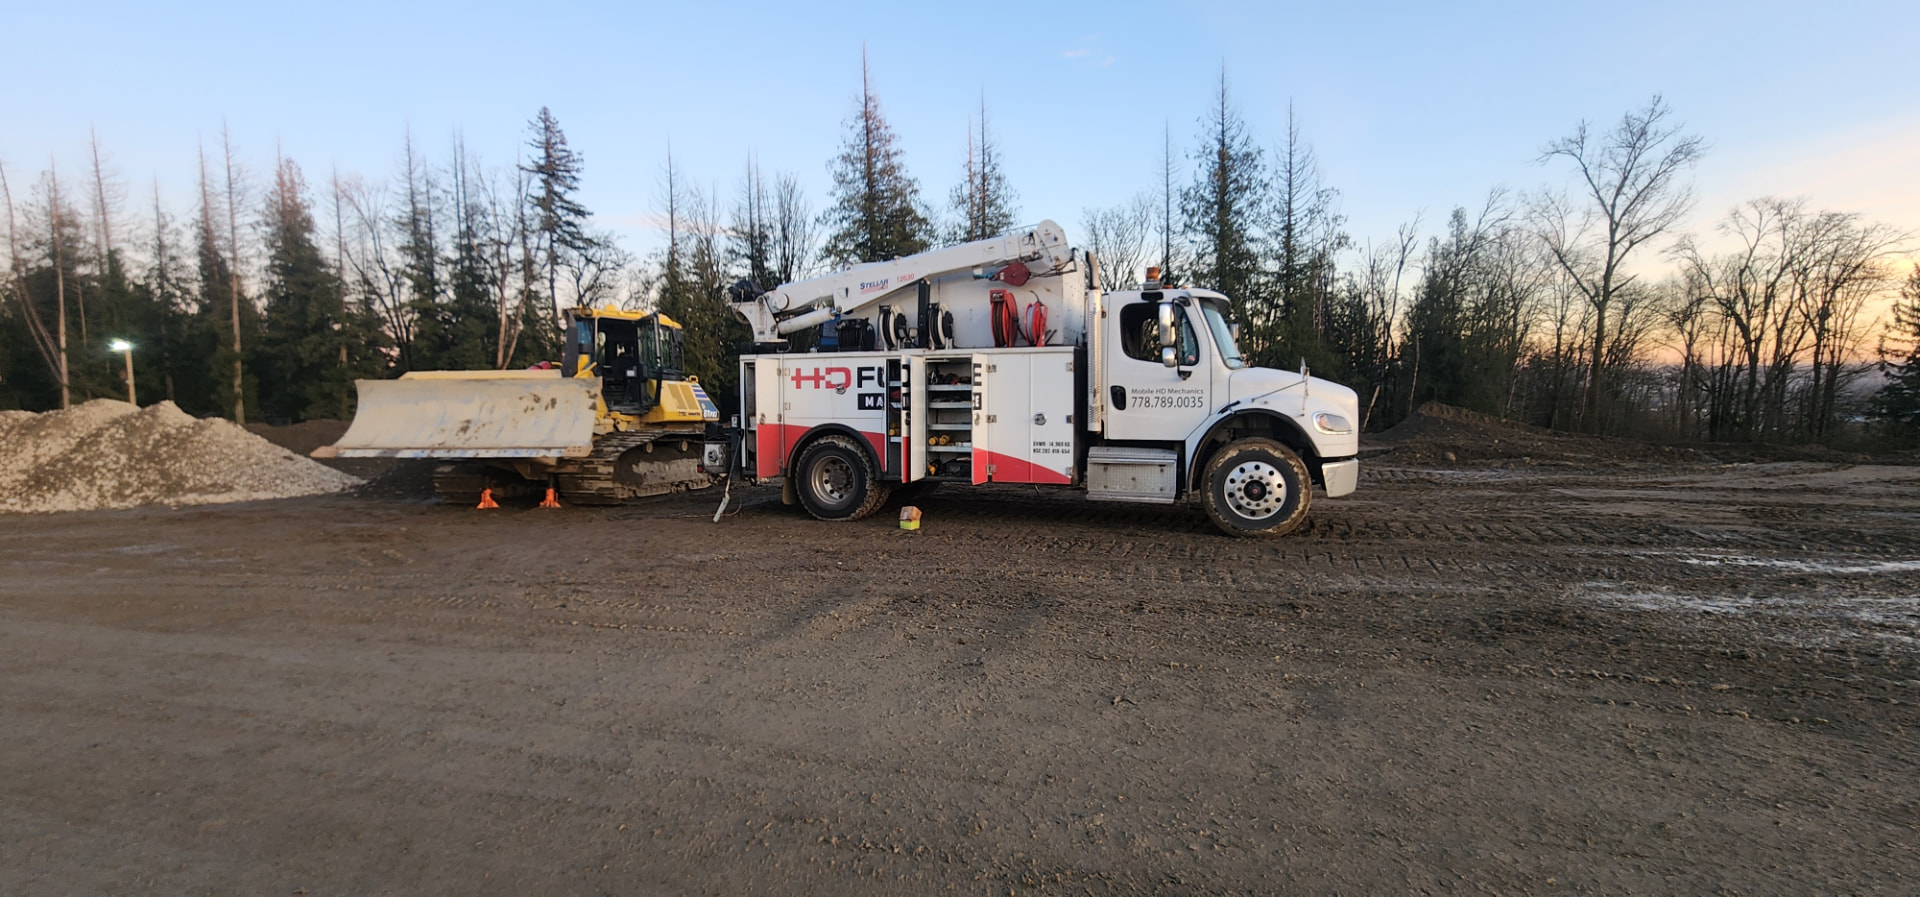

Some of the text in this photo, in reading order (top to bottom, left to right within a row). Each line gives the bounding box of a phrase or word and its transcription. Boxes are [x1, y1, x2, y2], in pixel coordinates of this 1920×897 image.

[860, 279, 889, 290] STELLAR
[791, 367, 852, 389] HD
[1131, 396, 1203, 408] 778.789.0035
